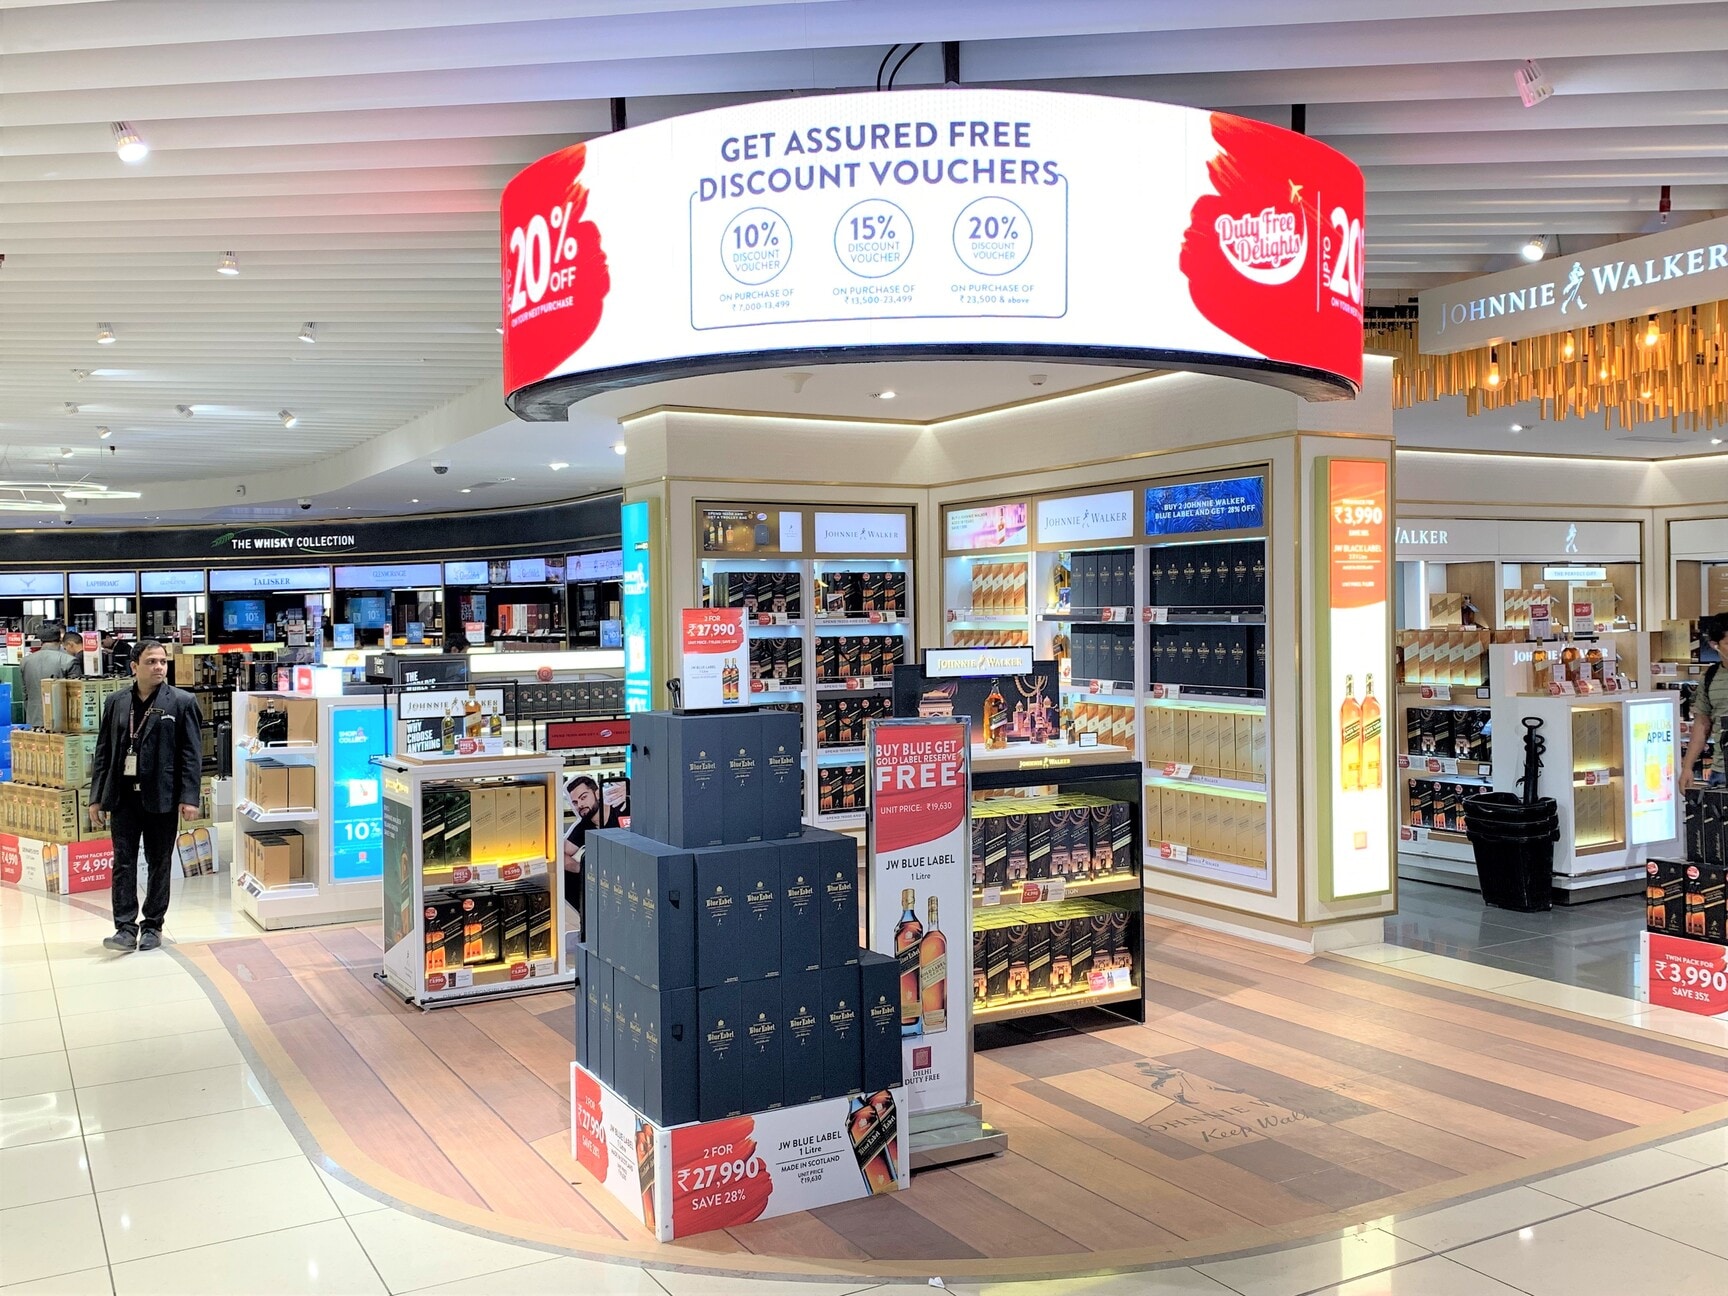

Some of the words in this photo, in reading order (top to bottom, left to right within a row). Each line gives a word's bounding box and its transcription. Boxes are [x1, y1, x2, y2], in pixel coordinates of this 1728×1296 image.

[721, 132, 776, 162] GET
[784, 122, 938, 156] ASSURED
[949, 121, 1031, 148] FREE
[700, 162, 861, 202] DISCOUNT
[869, 158, 1059, 186] VOUCHERS
[850, 215, 896, 241] 15%
[968, 216, 1019, 240] 20%
[1217, 217, 1260, 244] Duty
[1262, 210, 1294, 232] Free
[733, 221, 779, 249] 10%
[848, 241, 900, 253] DISCOUNT
[971, 242, 1015, 250] DISCOUNT
[1237, 234, 1300, 264] Delights
[510, 201, 578, 314] 20%
[733, 249, 780, 263] DISCOUNT
[850, 252, 901, 263] VOUCHER
[973, 251, 1015, 260] VOUCHER
[1322, 236, 1332, 288] UPTO
[735, 260, 781, 272] VOUCHER
[549, 266, 577, 293] OFF
[719, 293, 733, 302] ON
[734, 289, 780, 301] PURCHASE
[782, 288, 795, 297] OF
[832, 287, 847, 296] ON
[850, 285, 900, 295] PURCHASE
[902, 284, 917, 293] OF
[950, 285, 966, 293] ON
[968, 284, 1019, 293] PURCHASE
[1021, 284, 1035, 293] OF
[1437, 282, 1555, 335] JOHNNIE
[1591, 243, 1728, 295] WALKER
[540, 295, 574, 314] PURCHASE
[1007, 296, 1030, 304] above
[1183, 499, 1214, 509] JOHNNIE
[1215, 497, 1245, 506] WALKER
[1155, 511, 1172, 520] BLUE
[1173, 509, 1194, 518] LABEL
[1195, 508, 1210, 516] AND
[1211, 507, 1225, 515] GET
[1241, 504, 1256, 512] OFF
[1044, 516, 1081, 530] JOHNNIE
[1091, 512, 1127, 523] WALKER
[231, 539, 252, 550] THE
[253, 537, 294, 549] WHISKY
[296, 535, 355, 548] COLLECTION
[824, 530, 858, 540] JOHNNIE
[867, 530, 899, 539] WALKER
[1344, 544, 1363, 553] BLACK
[1363, 544, 1382, 553] LABEL
[252, 577, 291, 586] TALISKER
[937, 658, 977, 672] JOHNNIE
[986, 657, 1022, 667] WALKER
[1512, 649, 1559, 666] JOHIE
[405, 671, 419, 682] THE
[405, 701, 448, 713] JOHNNIE
[406, 721, 422, 734] WHY
[338, 735, 367, 743] COLLECT
[407, 729, 433, 744] CHOOSE
[1646, 730, 1672, 744] APPLE
[407, 738, 441, 754] ANYTHING
[876, 743, 899, 757] BUY
[902, 742, 932, 756] BLUE
[934, 740, 957, 754] GET
[876, 757, 898, 766] GOLD
[899, 755, 923, 765] LABEL
[924, 752, 957, 763] RESERVE
[1019, 760, 1043, 769] JOHNNIE
[1048, 758, 1071, 766] WALKER
[876, 762, 957, 792] FREE
[880, 805, 898, 815] UNIT
[899, 803, 923, 813] PRICE:
[926, 801, 953, 811] ₹19,630
[886, 859, 899, 871] JW
[901, 857, 925, 869] BLUE
[927, 854, 955, 866] LABEL
[915, 872, 931, 881] Litre
[1665, 953, 1682, 963] TWIN
[1682, 956, 1700, 967] PACK
[1700, 959, 1714, 969] FOR
[1654, 960, 1727, 992] ₹3,990
[1672, 986, 1693, 999] SAVE
[1694, 990, 1710, 1002] 35%
[904, 1075, 924, 1086] DUTY
[925, 1073, 941, 1082] FREE
[912, 1069, 932, 1078] DELHI
[778, 1140, 791, 1151] JW
[792, 1136, 814, 1148] BLUE
[816, 1130, 842, 1143] LABEL
[1201, 1125, 1254, 1143] Keep
[582, 1134, 594, 1152] SAVE
[804, 1145, 822, 1155] Litre
[703, 1148, 709, 1159] 2
[711, 1143, 733, 1156] FOR
[780, 1163, 799, 1173] MADE
[808, 1155, 840, 1167] SCOTLAND
[677, 1159, 760, 1192] ₹27,990
[800, 1174, 822, 1184] ₹19,630
[809, 1168, 824, 1177] PRICE
[691, 1193, 722, 1211] SAVE
[724, 1188, 746, 1204] 28%
